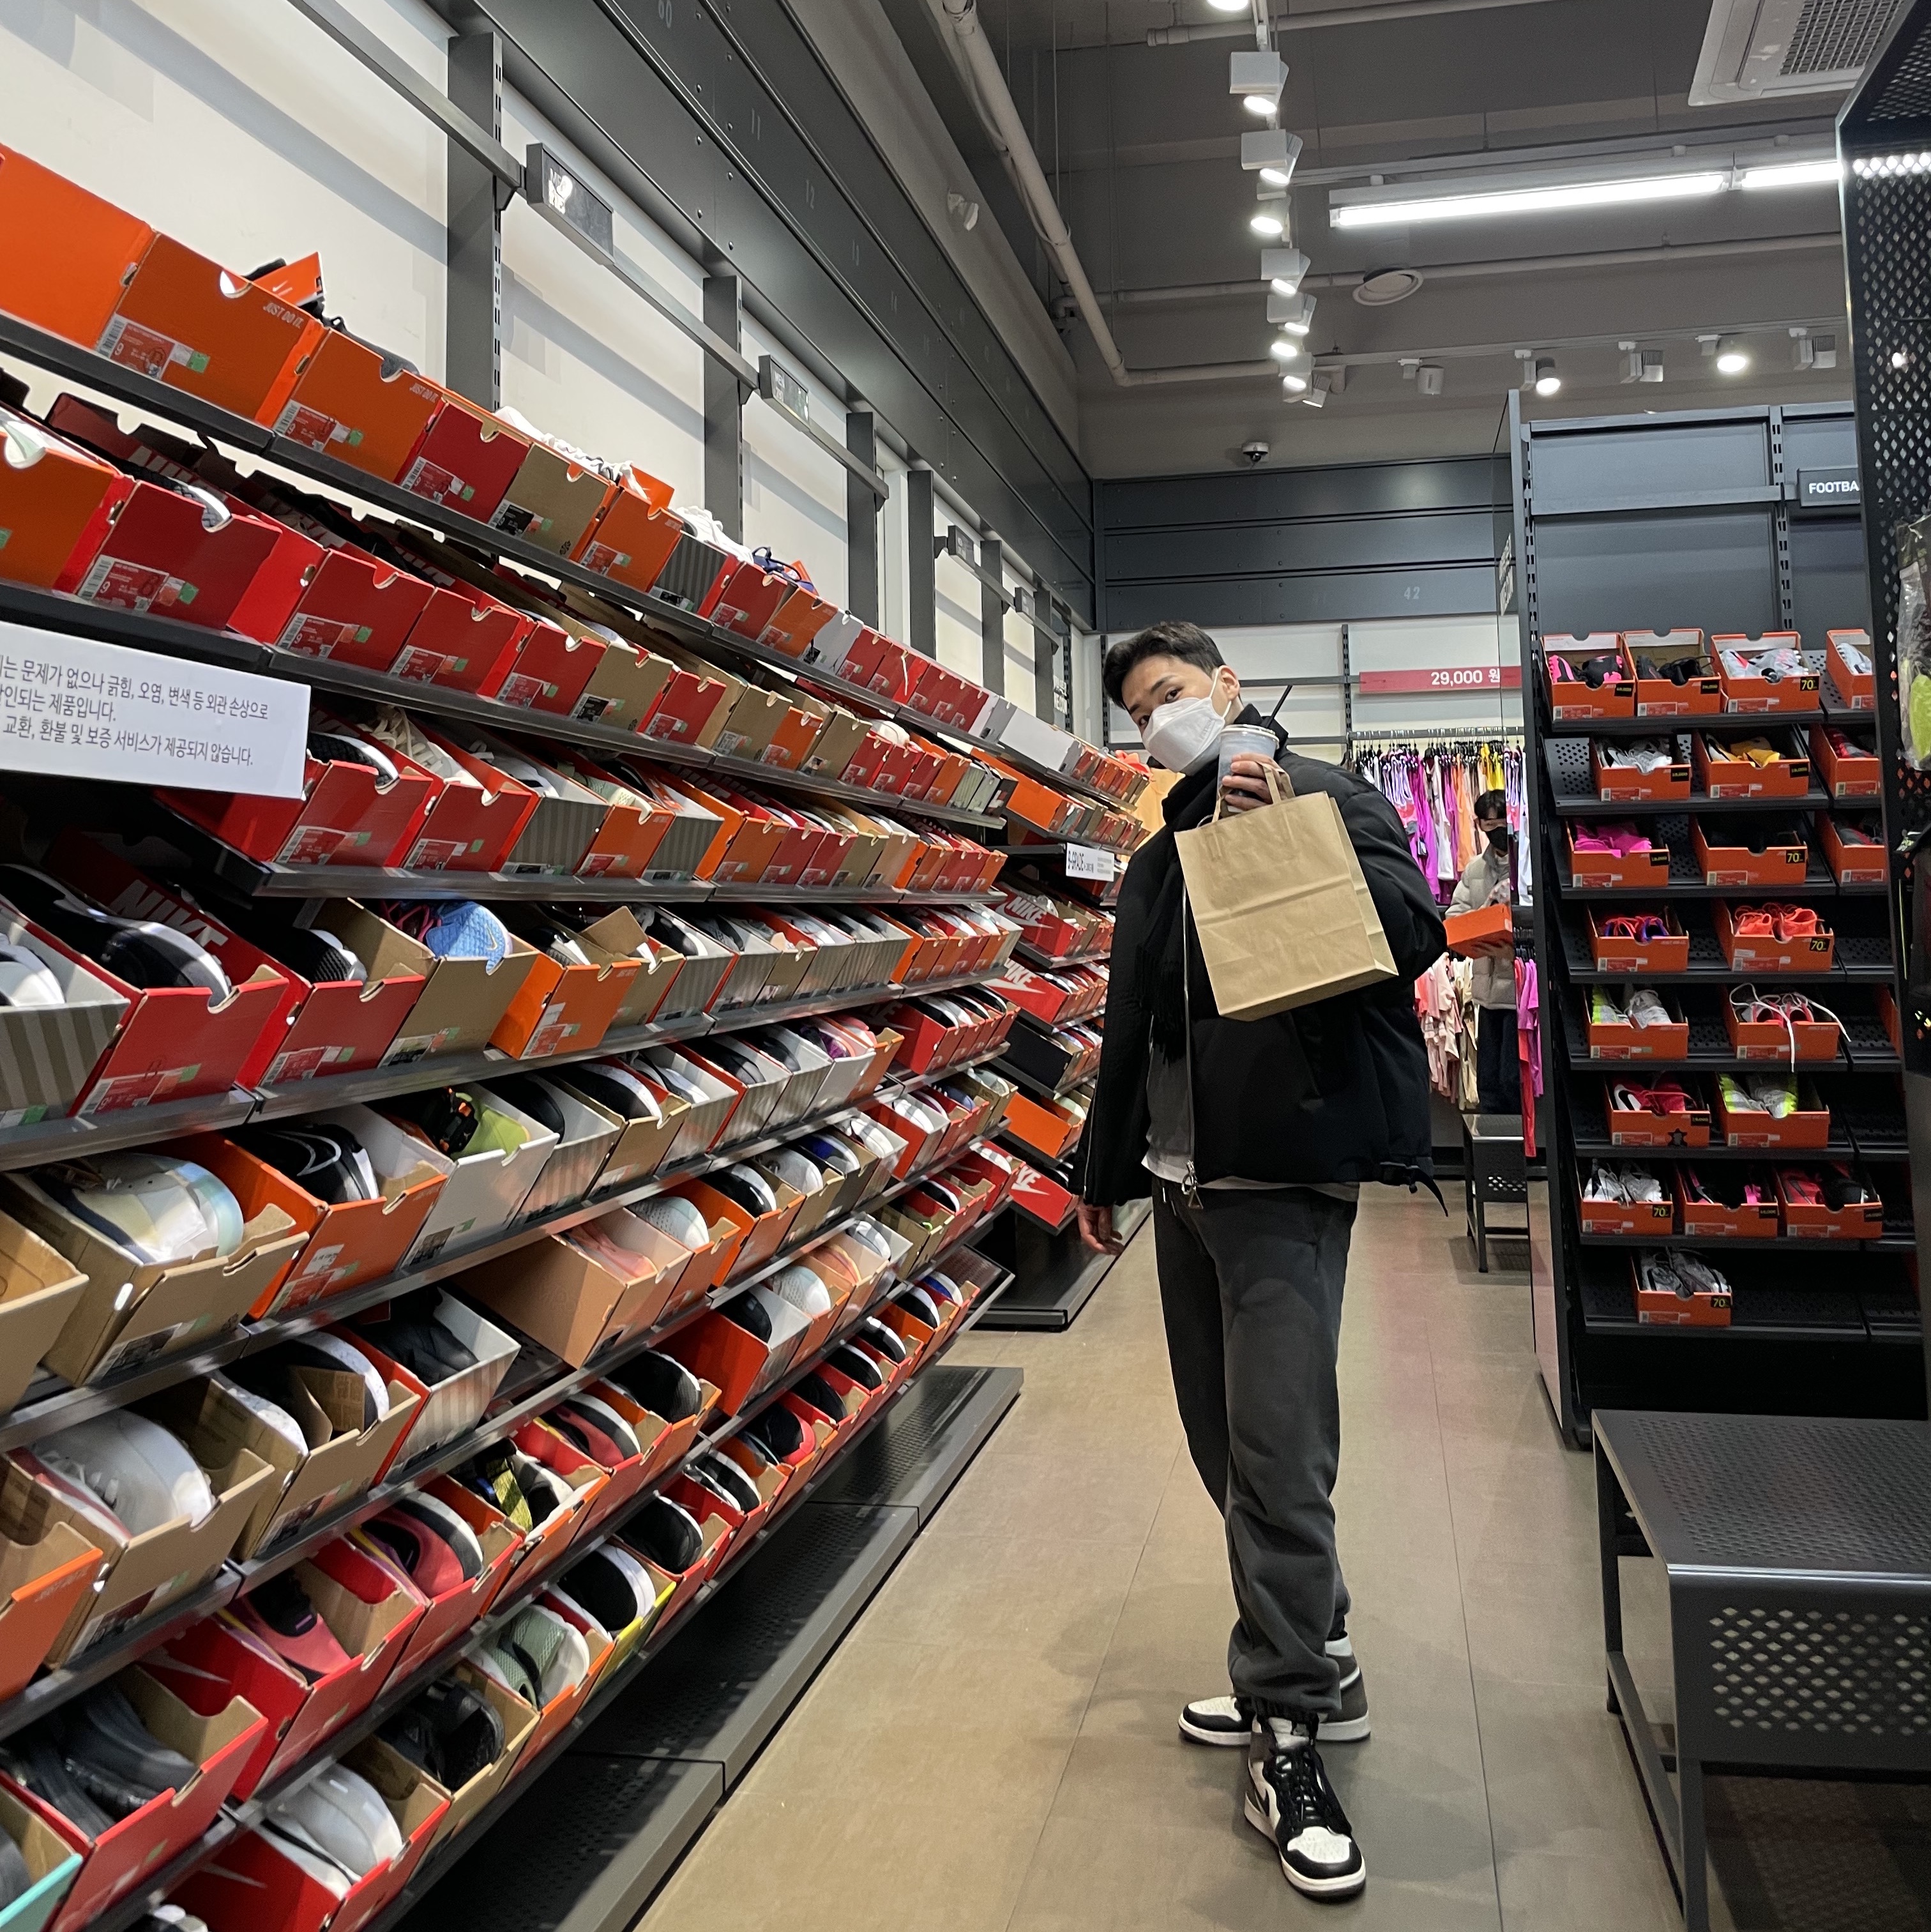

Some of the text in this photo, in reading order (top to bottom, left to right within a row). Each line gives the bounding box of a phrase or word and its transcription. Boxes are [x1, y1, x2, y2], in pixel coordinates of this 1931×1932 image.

[1404, 586, 1421, 600] 42
[1430, 668, 1501, 687] 29,000 원
[1801, 679, 1814, 690] 70
[21, 660, 63, 687] 문제가
[66, 668, 105, 694] 없으나
[107, 676, 134, 699] 긁힘,
[138, 681, 164, 705] 오염,
[169, 686, 191, 709] 변색
[193, 692, 204, 711] 등
[206, 694, 227, 715] 외관
[229, 697, 268, 720] 손상으로
[49, 693, 116, 722] 제품입니다.
[3, 715, 254, 766] 교환, 환불 및 보증 서비스가 제공되지 않습니다.
[1787, 852, 1799, 863] 70
[1006, 895, 1047, 924] NIKE
[1811, 940, 1824, 951] 70
[1654, 1206, 1666, 1217] 70
[1713, 1297, 1726, 1308] 70
